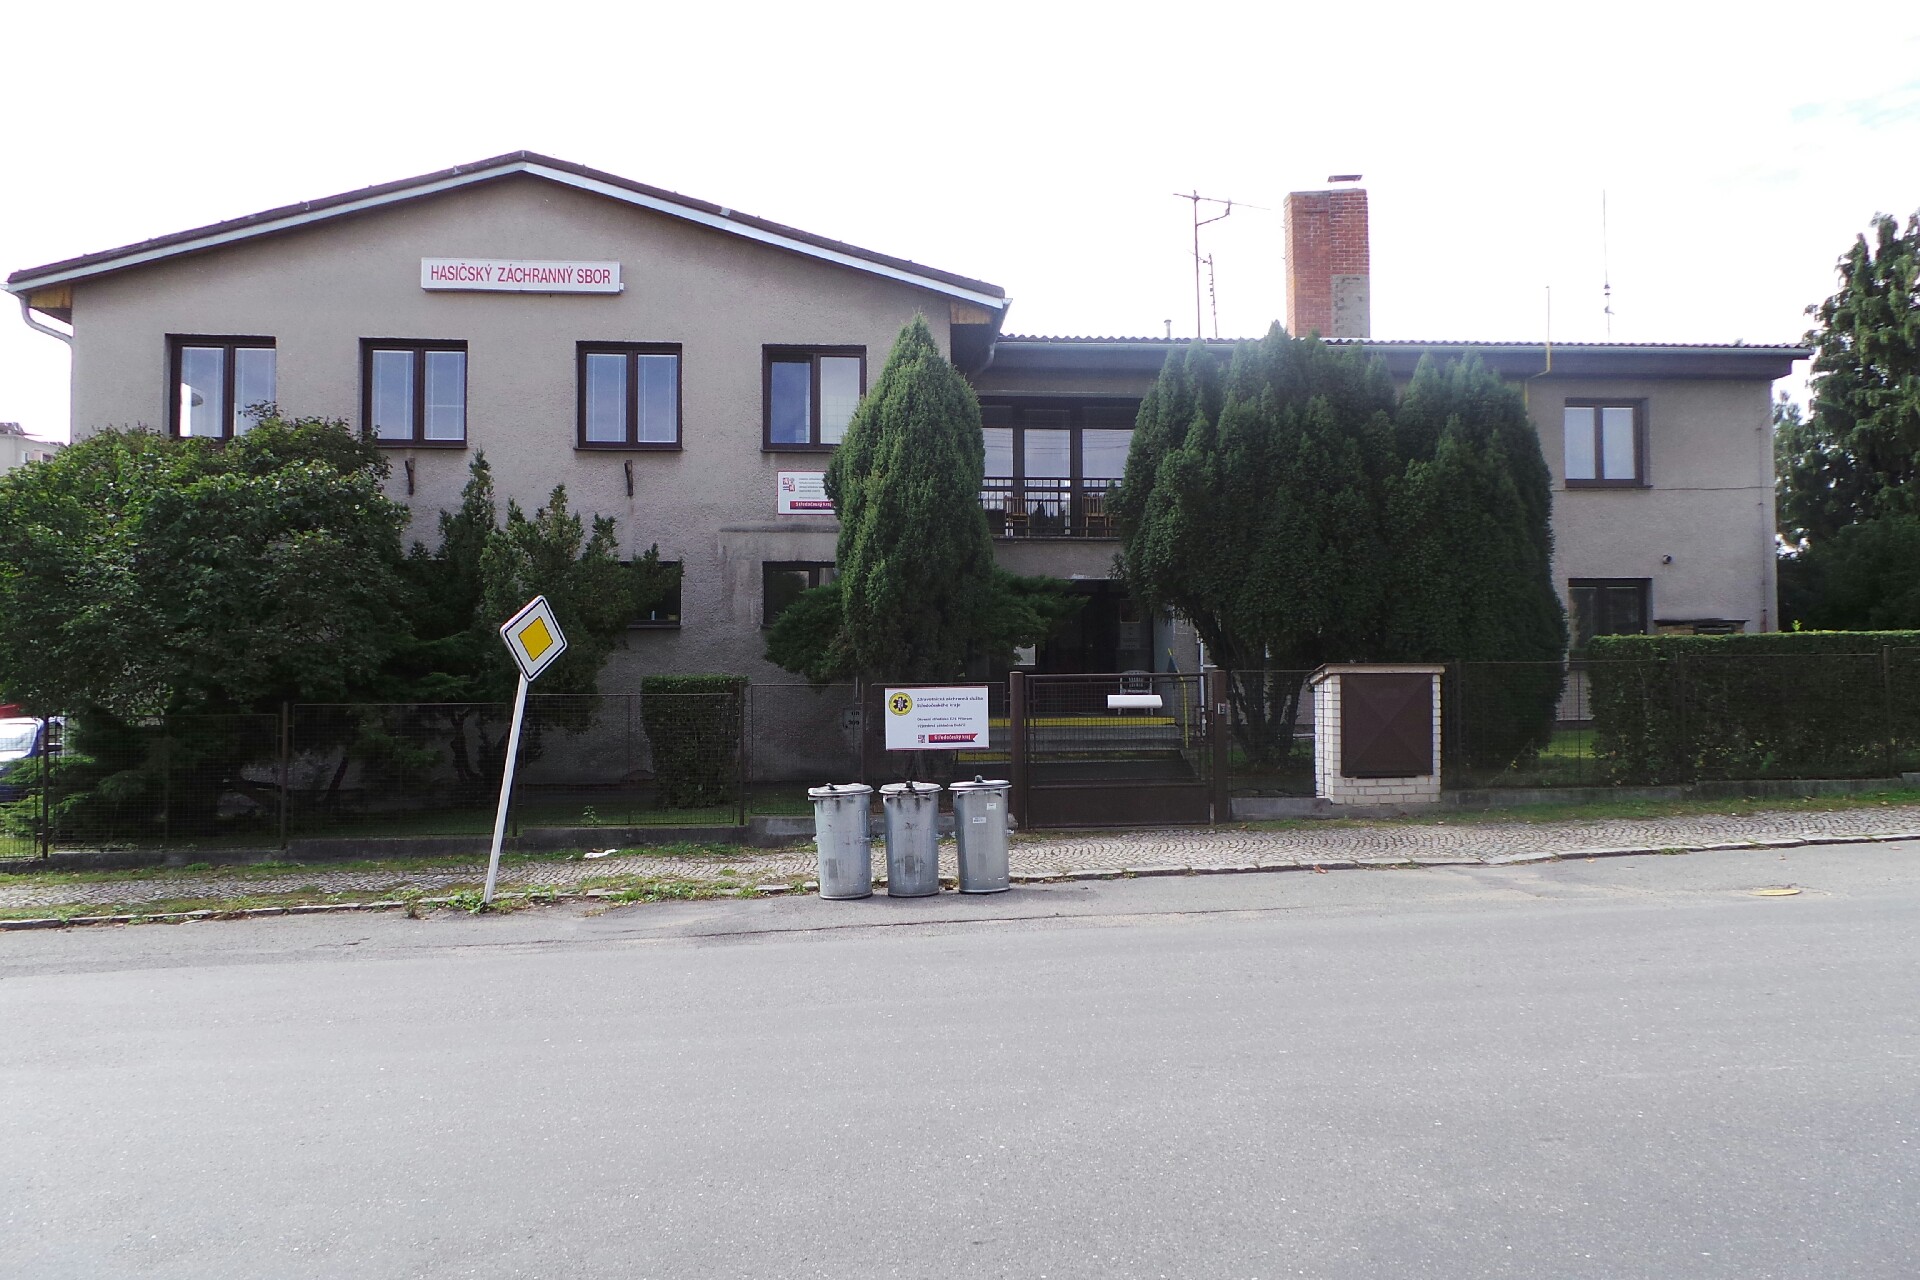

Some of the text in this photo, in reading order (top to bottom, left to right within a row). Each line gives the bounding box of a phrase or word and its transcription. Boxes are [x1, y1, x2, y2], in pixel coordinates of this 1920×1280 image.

[431, 263, 611, 284] HASIČSKÝ ZÁCHRANNÝ SBOR
